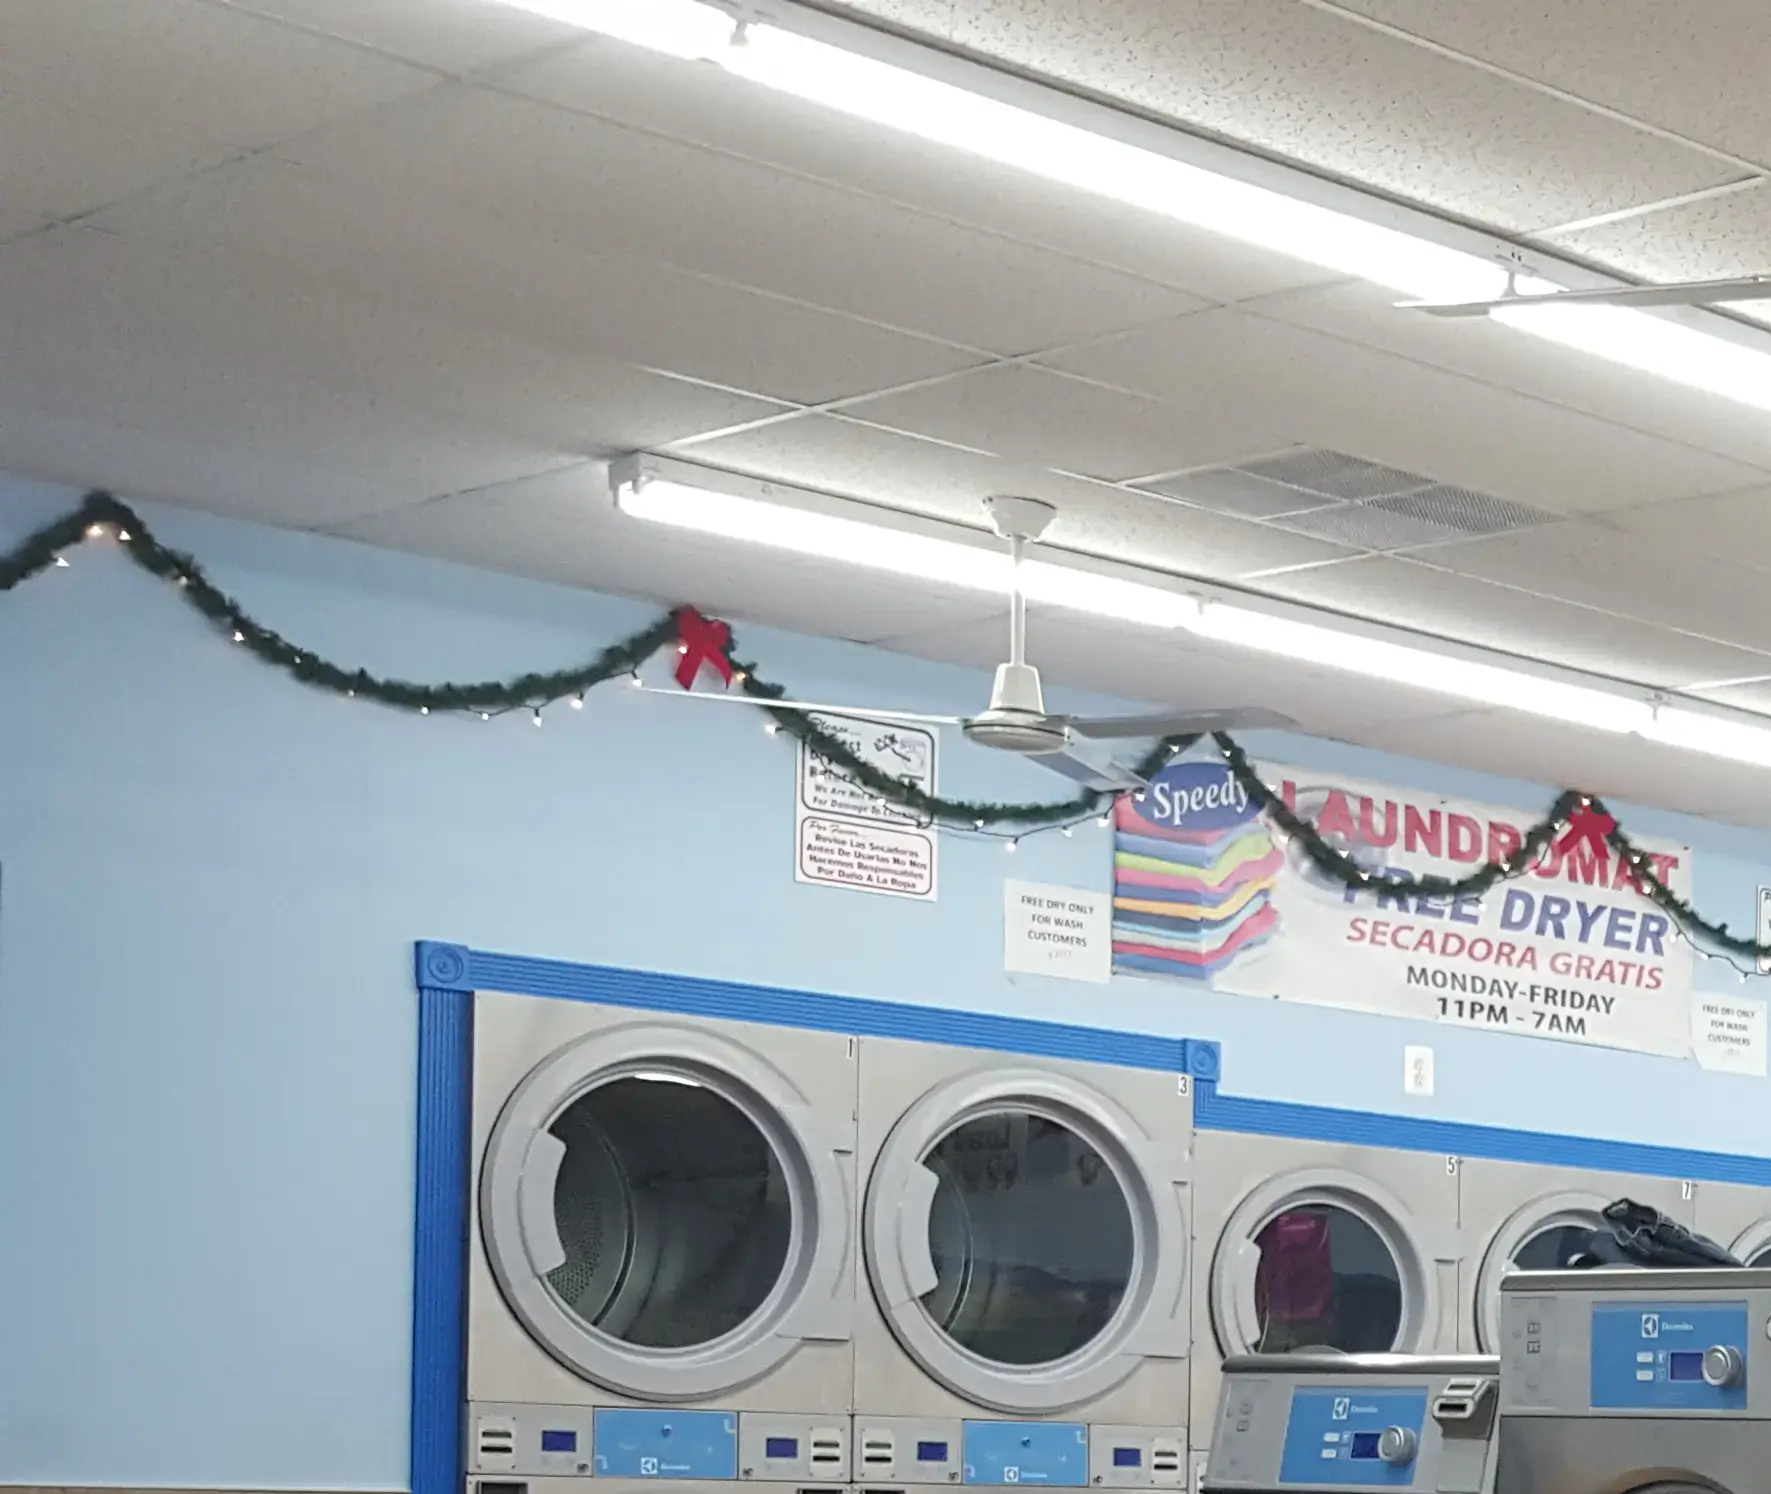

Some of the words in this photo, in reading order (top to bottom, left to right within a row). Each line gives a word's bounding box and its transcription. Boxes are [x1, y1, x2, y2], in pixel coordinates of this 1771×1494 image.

[1153, 771, 1250, 826] Speedy
[815, 834, 847, 847] Revise
[850, 840, 866, 850] Las
[806, 843, 834, 856] Antes
[838, 847, 851, 857] De
[854, 850, 890, 864] Usarlas
[893, 856, 906, 866] No
[909, 858, 928, 870] Nos
[809, 854, 854, 869] Hacemos
[857, 861, 925, 880] Responsables
[817, 866, 834, 878] Por
[877, 875, 888, 886] La
[891, 877, 917, 890] Ropa
[1021, 895, 1044, 908] FREE
[1046, 899, 1066, 910] DRY
[1068, 903, 1094, 914] ONLY
[1032, 914, 1051, 925] FOR
[1054, 918, 1083, 929] WASH
[1500, 888, 1669, 957] DRYER
[1028, 930, 1087, 947] CUSTOMERS
[1347, 917, 1539, 971] SECADORA
[1549, 950, 1664, 991] GRATIS
[1405, 964, 1617, 1016] MONDAY-FRIDAY
[1436, 996, 1509, 1025] 11PM
[1531, 1010, 1587, 1036] 7AM
[1179, 1076, 1188, 1094] 3
[1447, 1157, 1455, 1174] 5
[1683, 1182, 1691, 1198] 7
